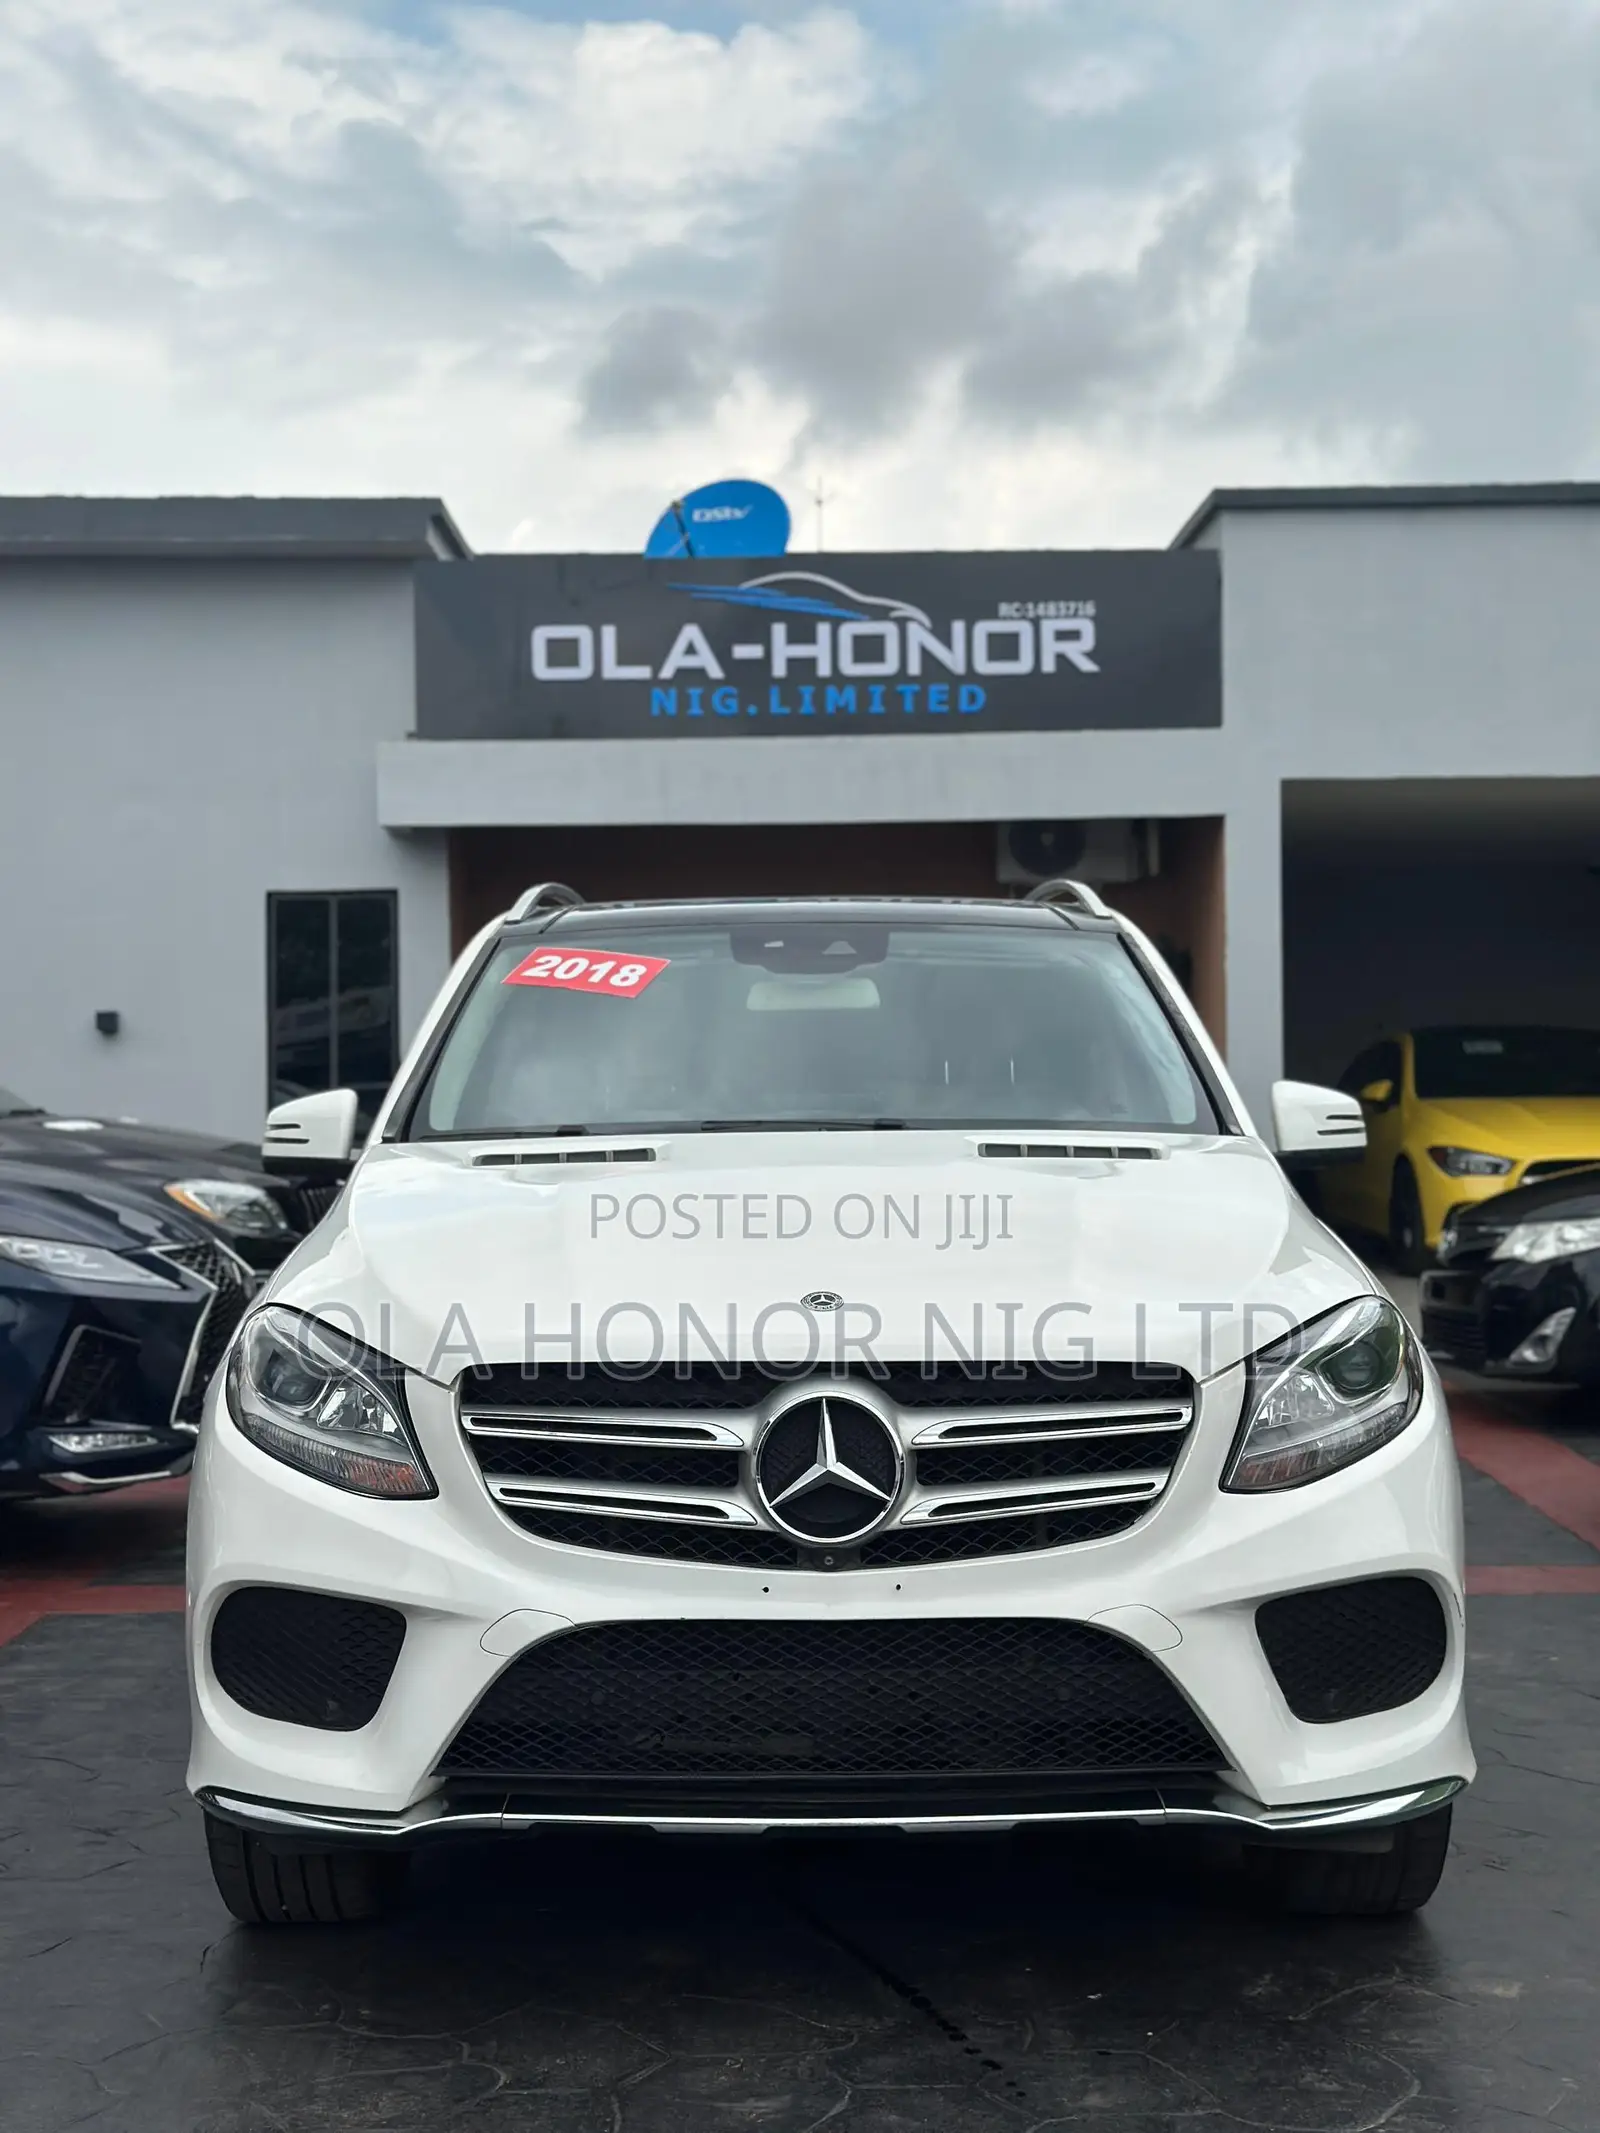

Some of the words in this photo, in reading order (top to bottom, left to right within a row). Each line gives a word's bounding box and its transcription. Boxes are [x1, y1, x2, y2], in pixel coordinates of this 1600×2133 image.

[531, 619, 1100, 681] OLA-HONOR
[650, 684, 987, 717] NIG.LIMITED
[520, 955, 647, 987] 2018
